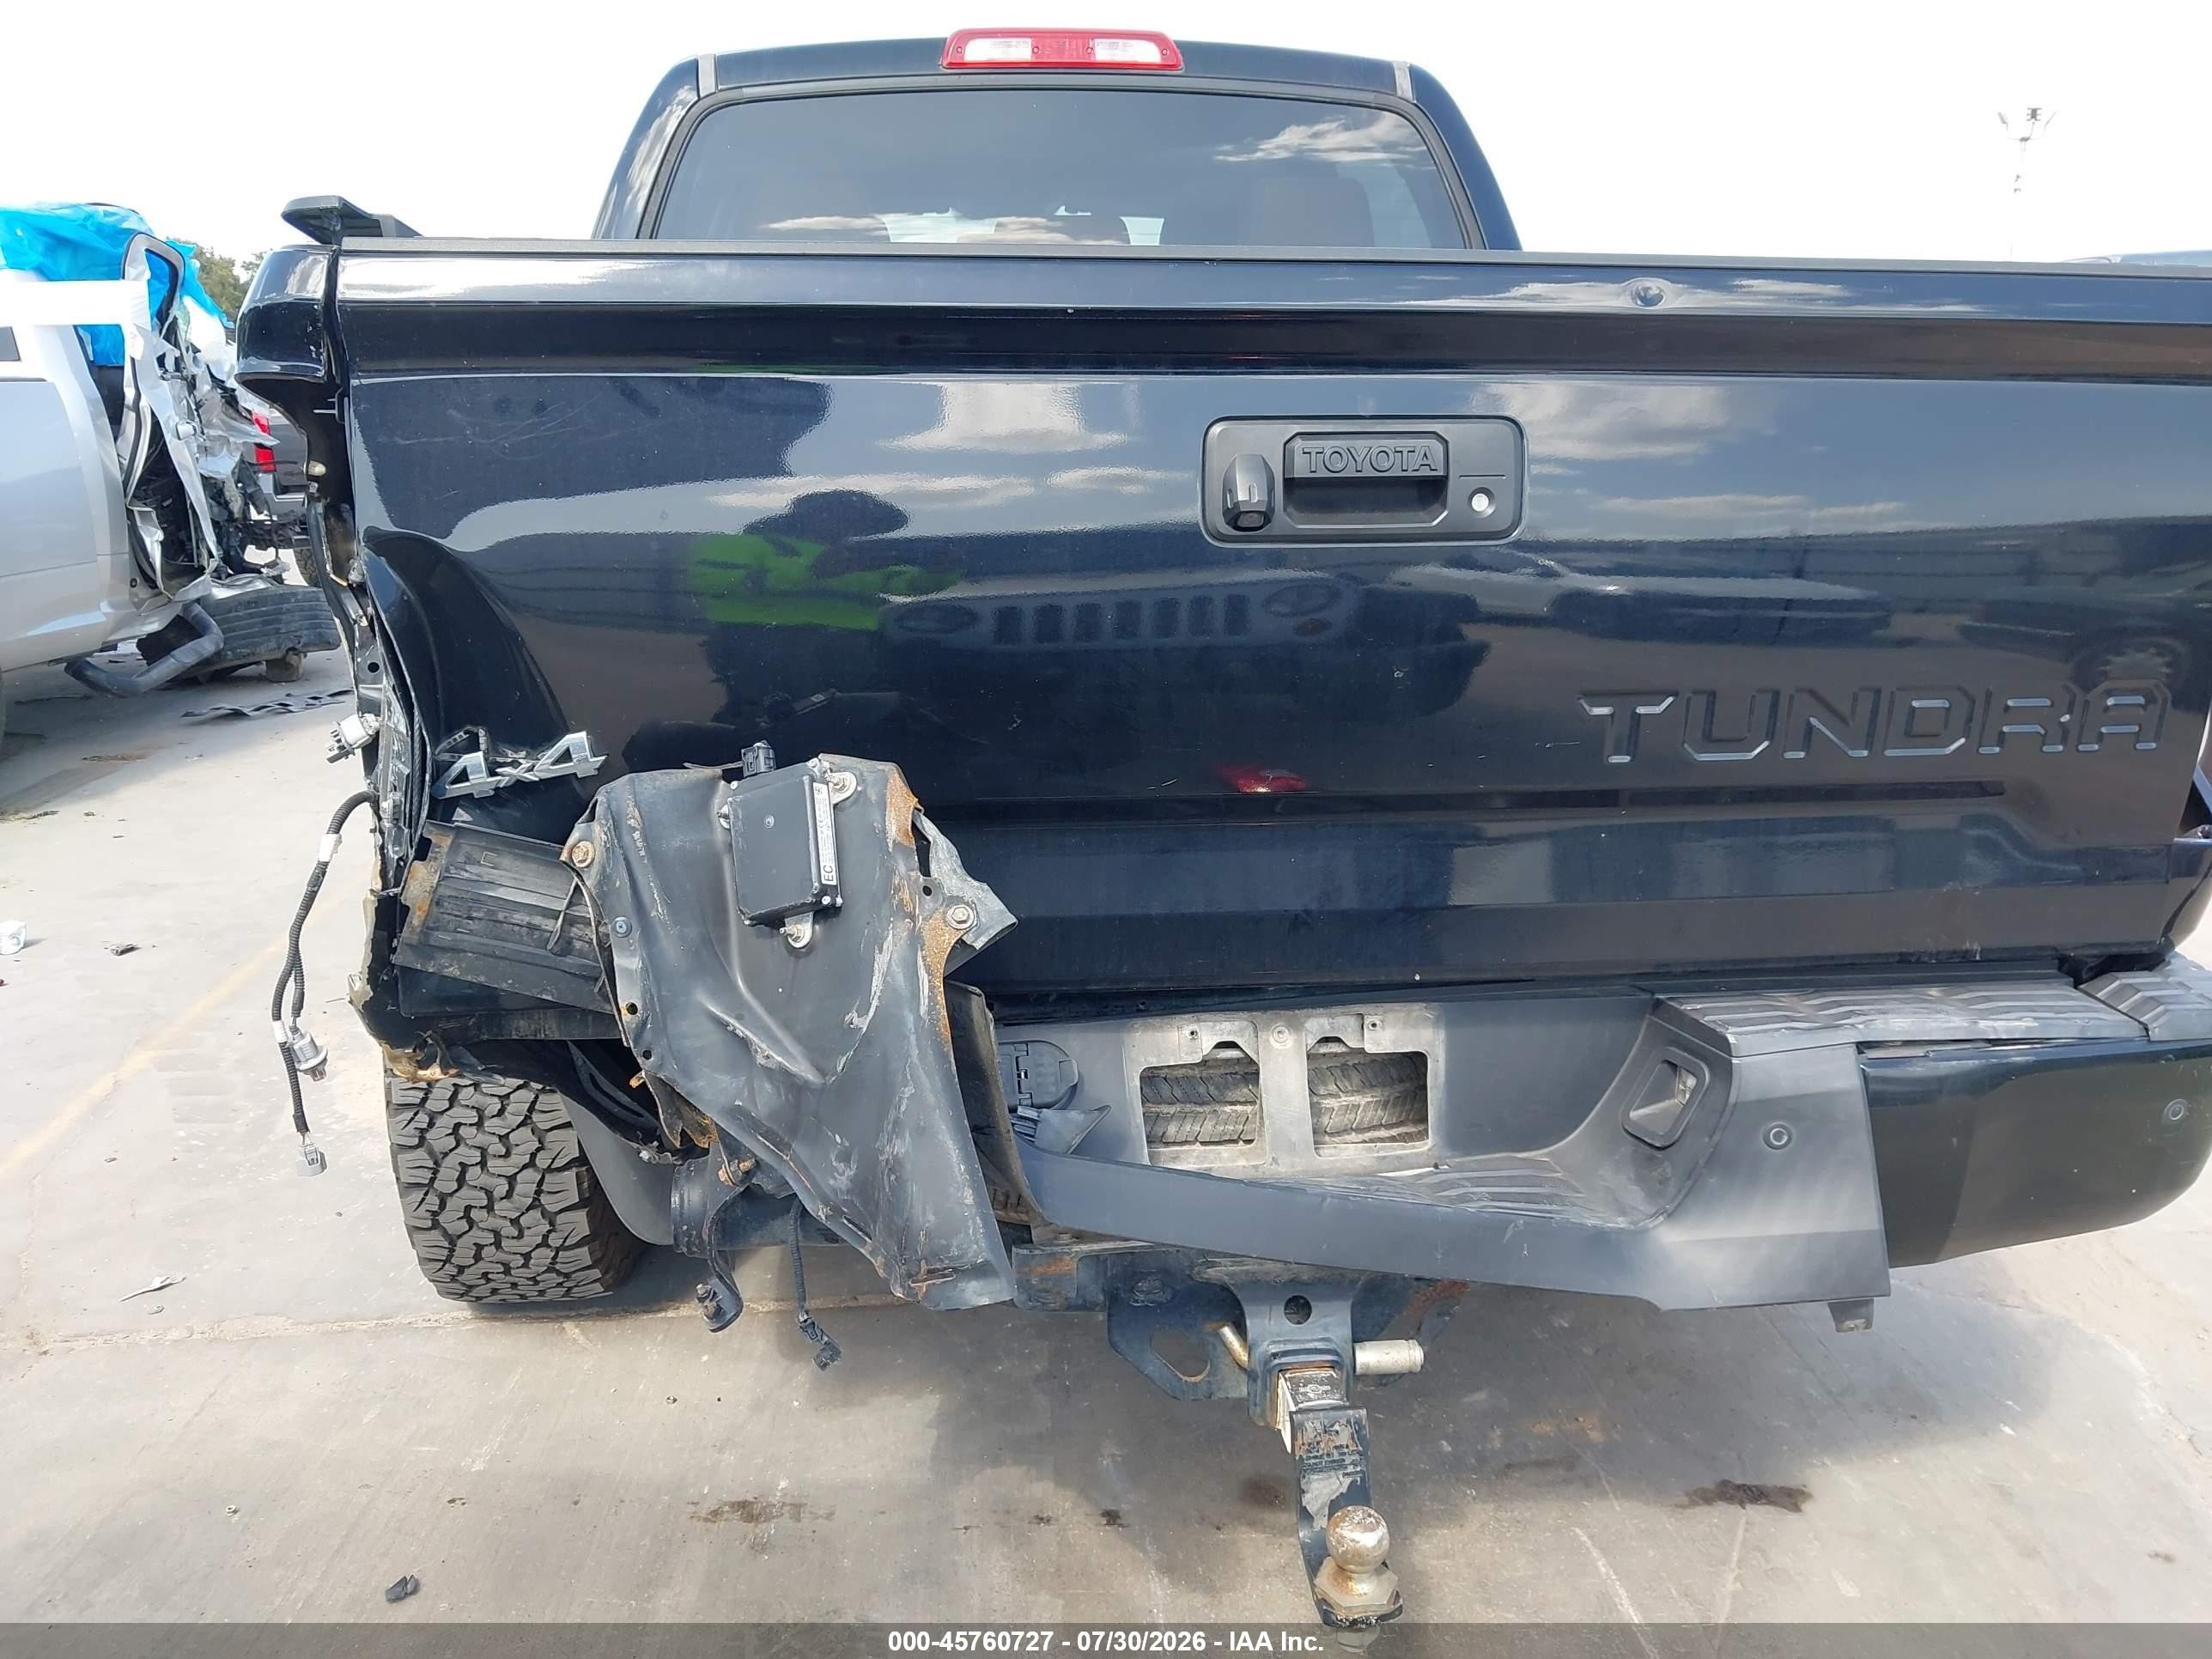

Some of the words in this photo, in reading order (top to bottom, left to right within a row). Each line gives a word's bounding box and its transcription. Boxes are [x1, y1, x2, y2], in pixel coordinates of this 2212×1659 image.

[1302, 445, 1438, 474] TOYOTA
[1577, 679, 2172, 763] TUNDRA
[823, 864, 834, 882] EC
